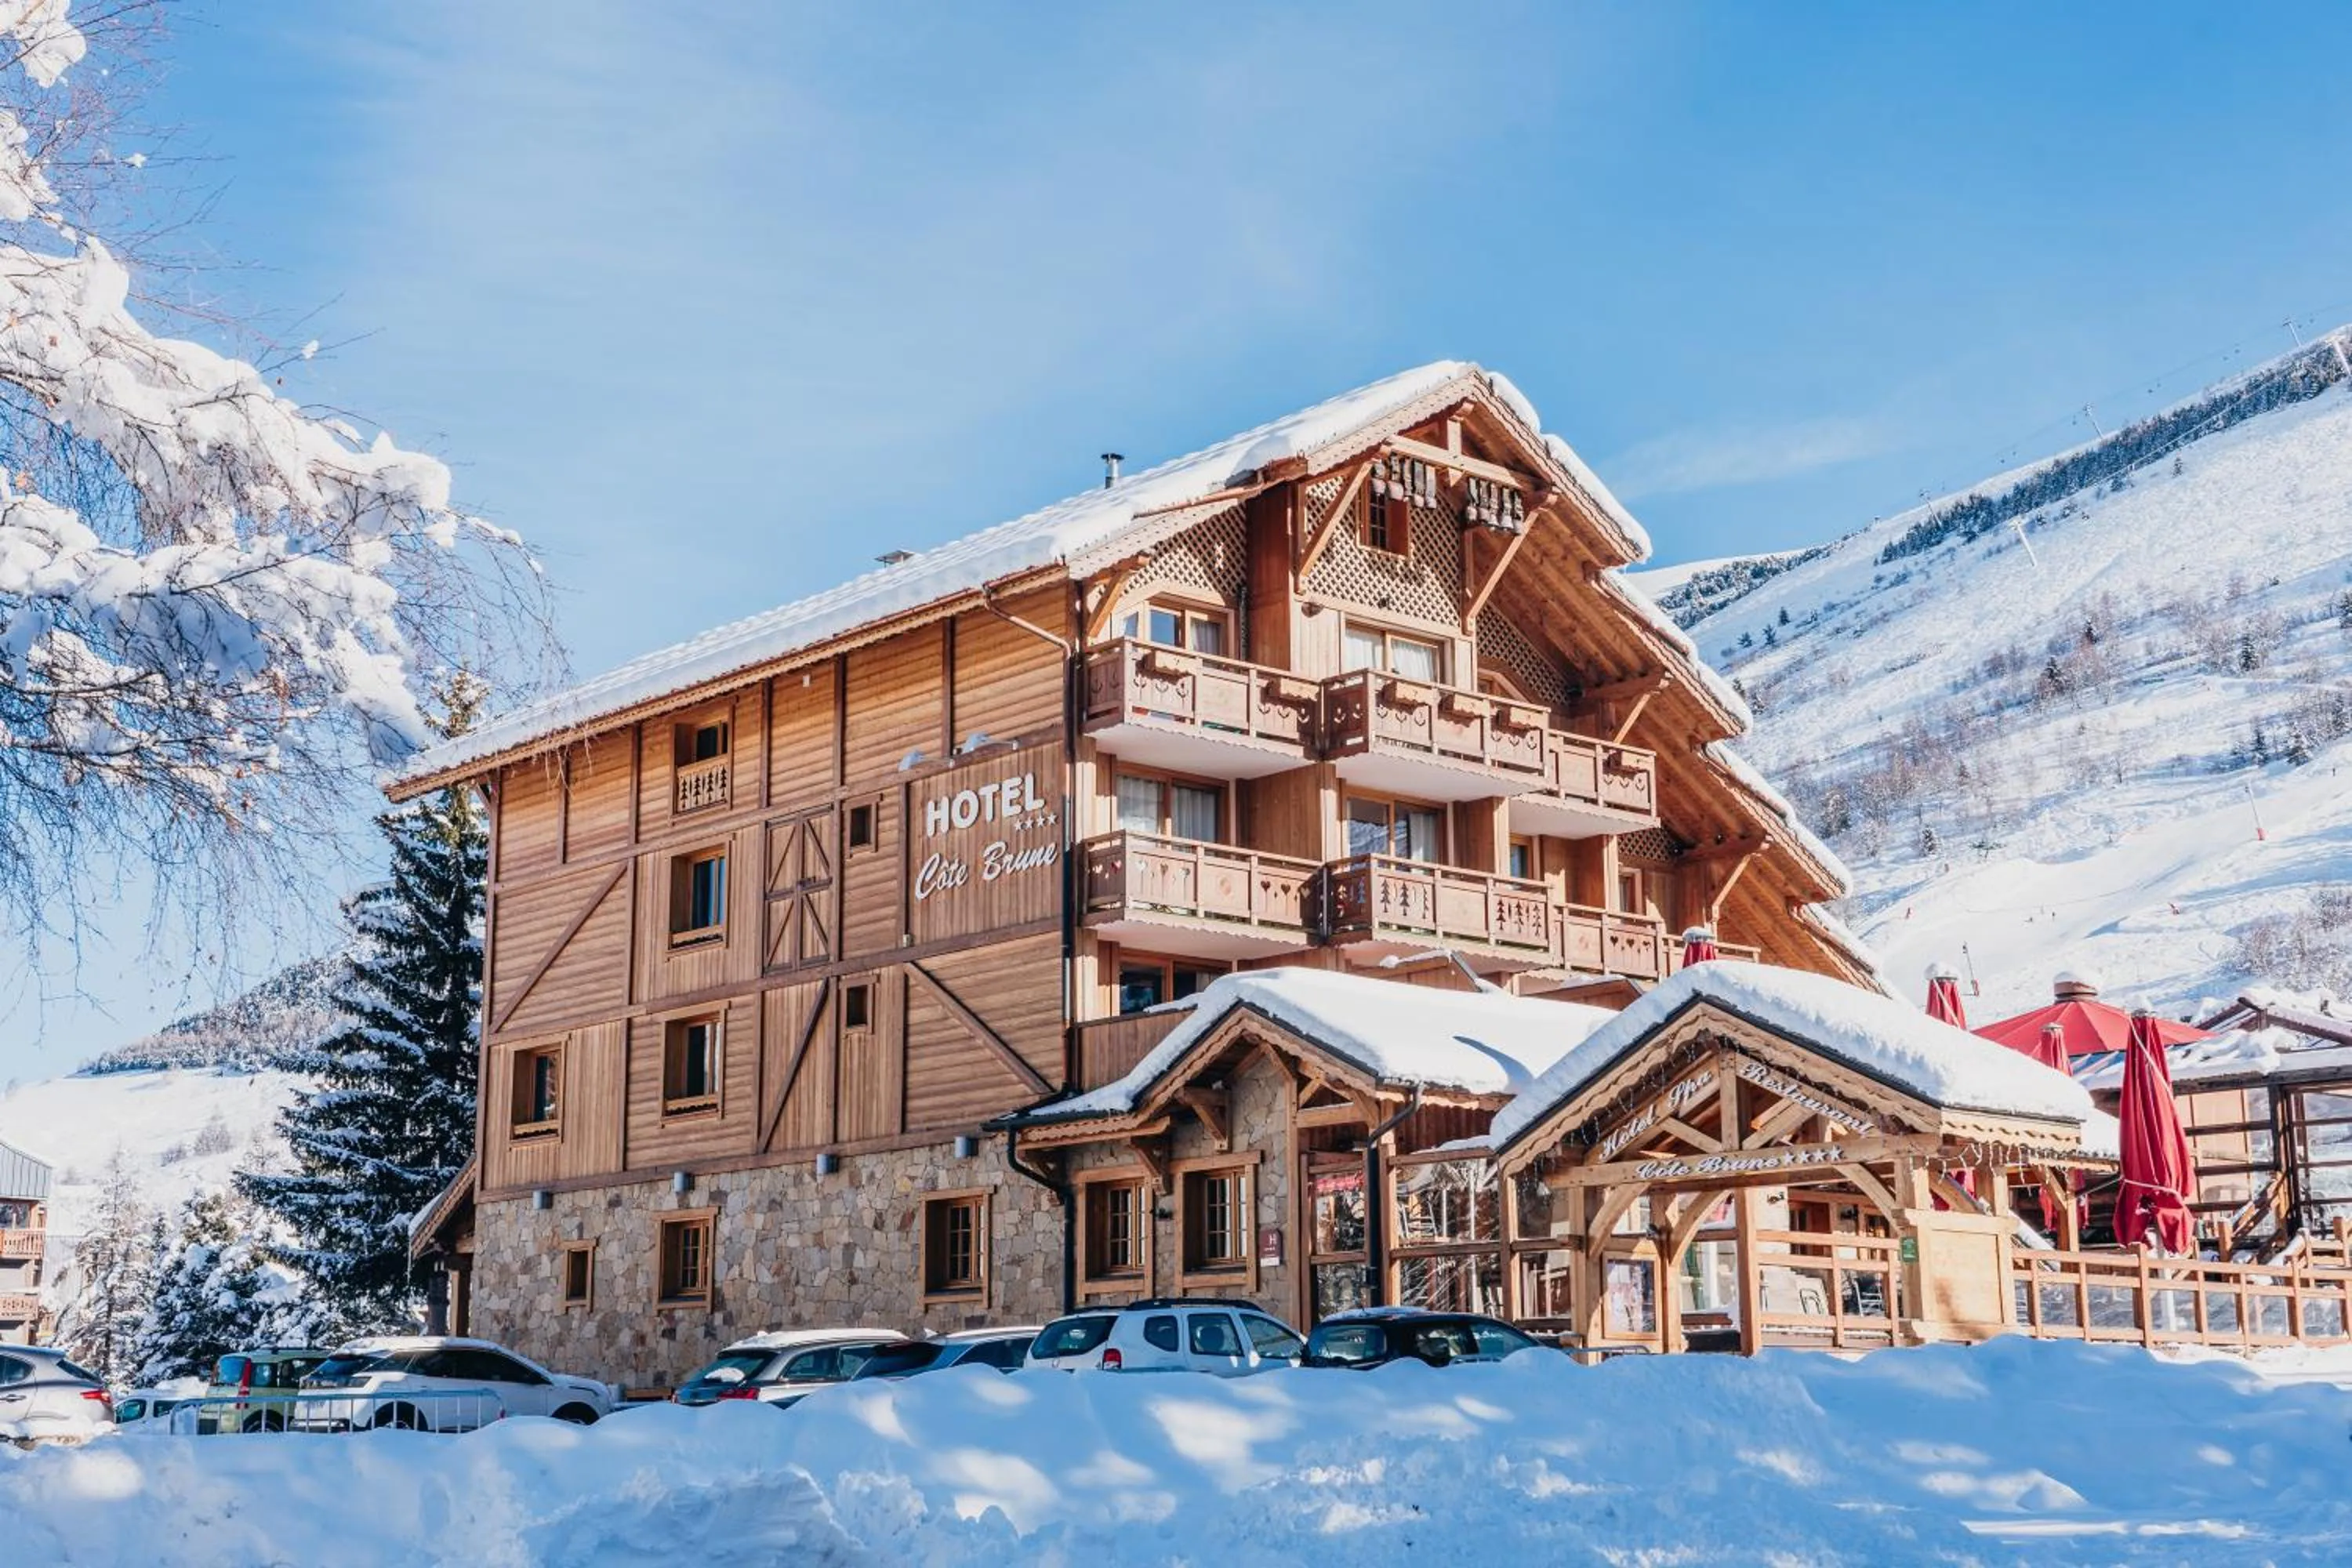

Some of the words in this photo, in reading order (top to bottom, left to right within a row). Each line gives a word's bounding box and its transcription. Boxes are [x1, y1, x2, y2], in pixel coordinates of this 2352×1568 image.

[926, 772, 1045, 837] HOTEL
[982, 840, 1058, 880] Brune
[1668, 1071, 1713, 1109] Spa
[1740, 1062, 1875, 1137] Restaurant
[1695, 1156, 1780, 1173] Brune
